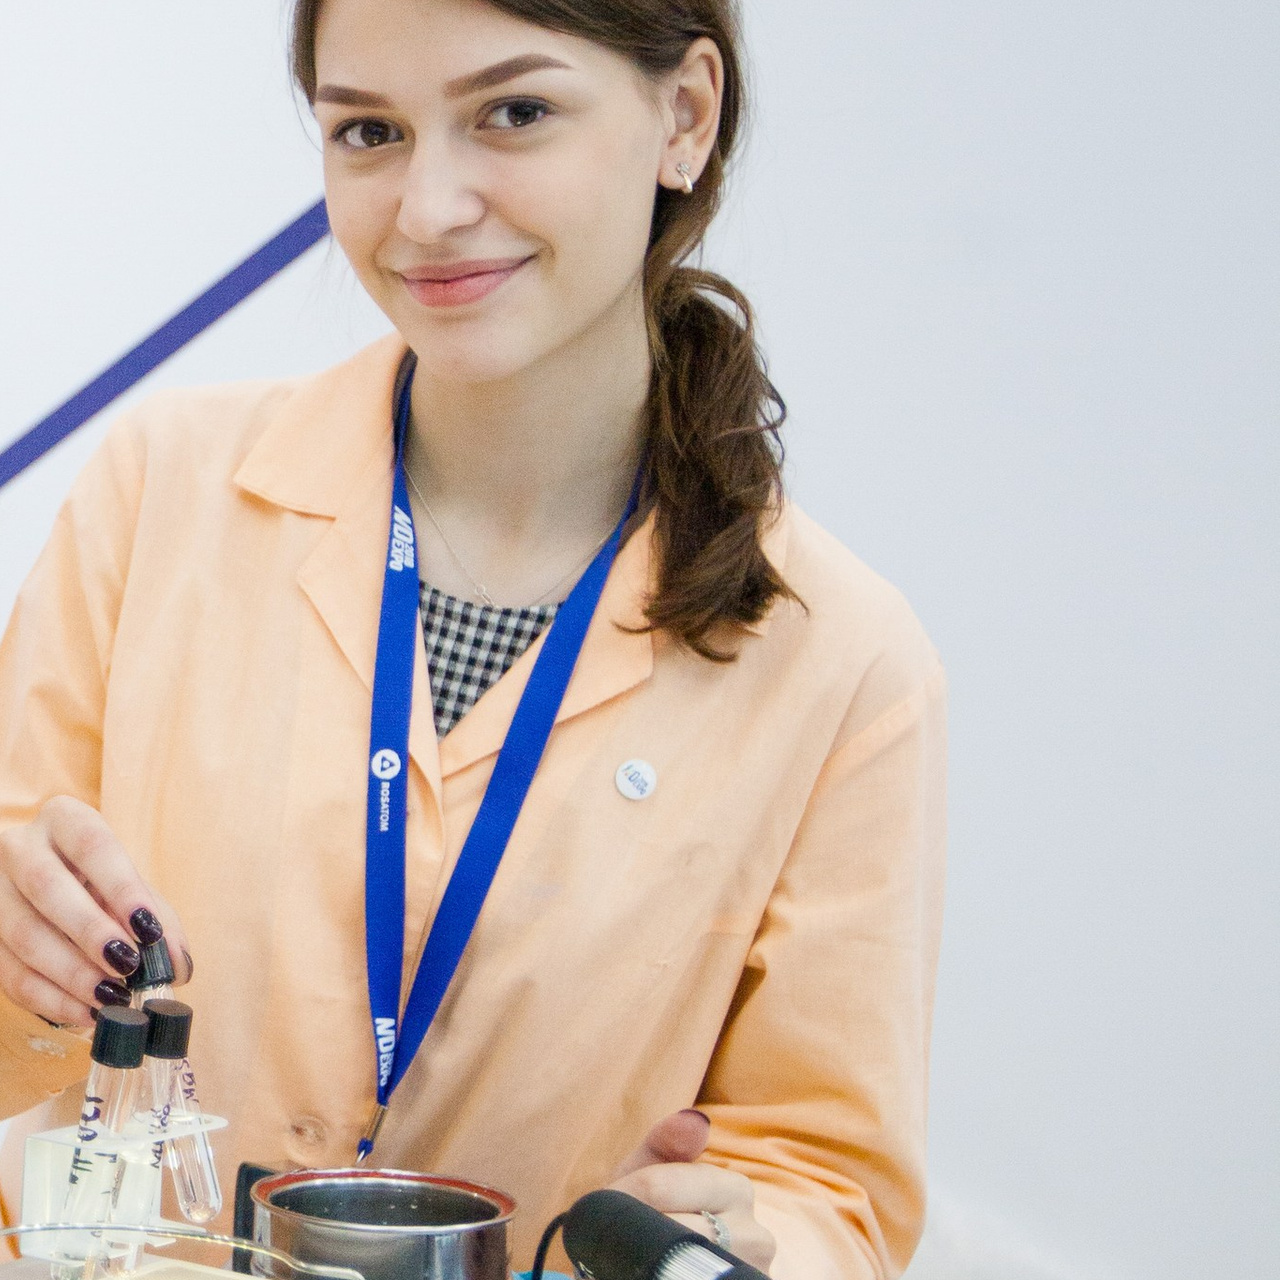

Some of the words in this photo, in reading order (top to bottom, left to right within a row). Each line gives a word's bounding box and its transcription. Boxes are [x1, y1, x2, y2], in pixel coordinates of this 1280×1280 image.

[393, 504, 414, 546] ND
[389, 537, 406, 573] EXPO
[379, 781, 391, 832] ROSATOM
[374, 1017, 396, 1054] ND
